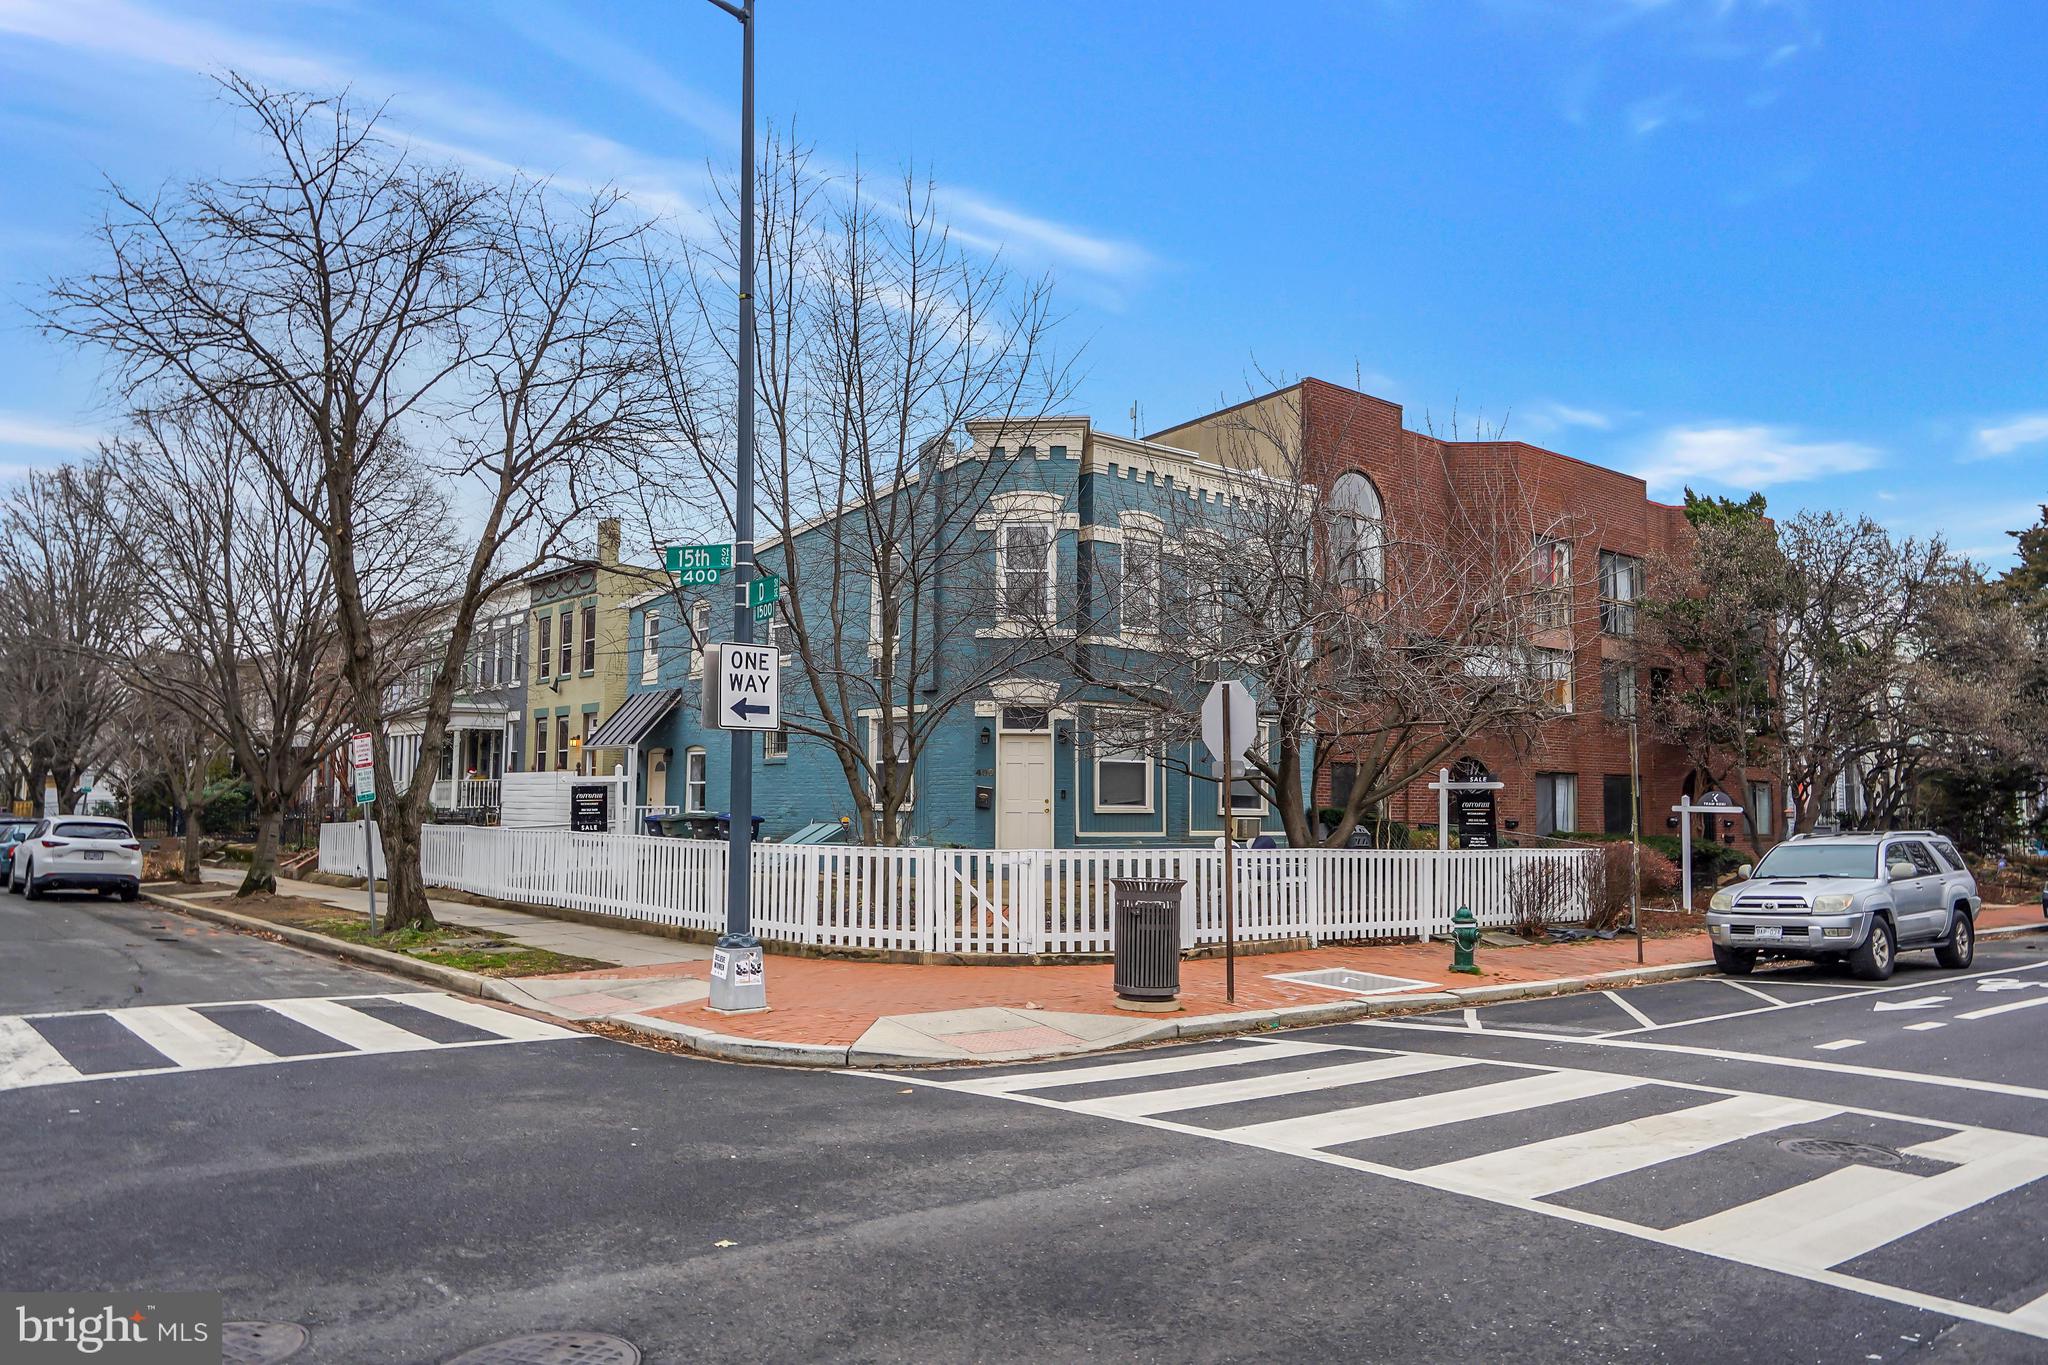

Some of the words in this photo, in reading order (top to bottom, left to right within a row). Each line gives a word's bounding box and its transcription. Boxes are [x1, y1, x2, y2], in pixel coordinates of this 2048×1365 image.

[677, 549, 710, 568] 15th
[721, 548, 730, 557] St
[720, 557, 730, 566] SE
[683, 570, 717, 583] 400
[759, 583, 764, 601] D
[756, 602, 773, 618] 1500
[731, 650, 769, 671] ONE
[729, 673, 770, 693] WAY
